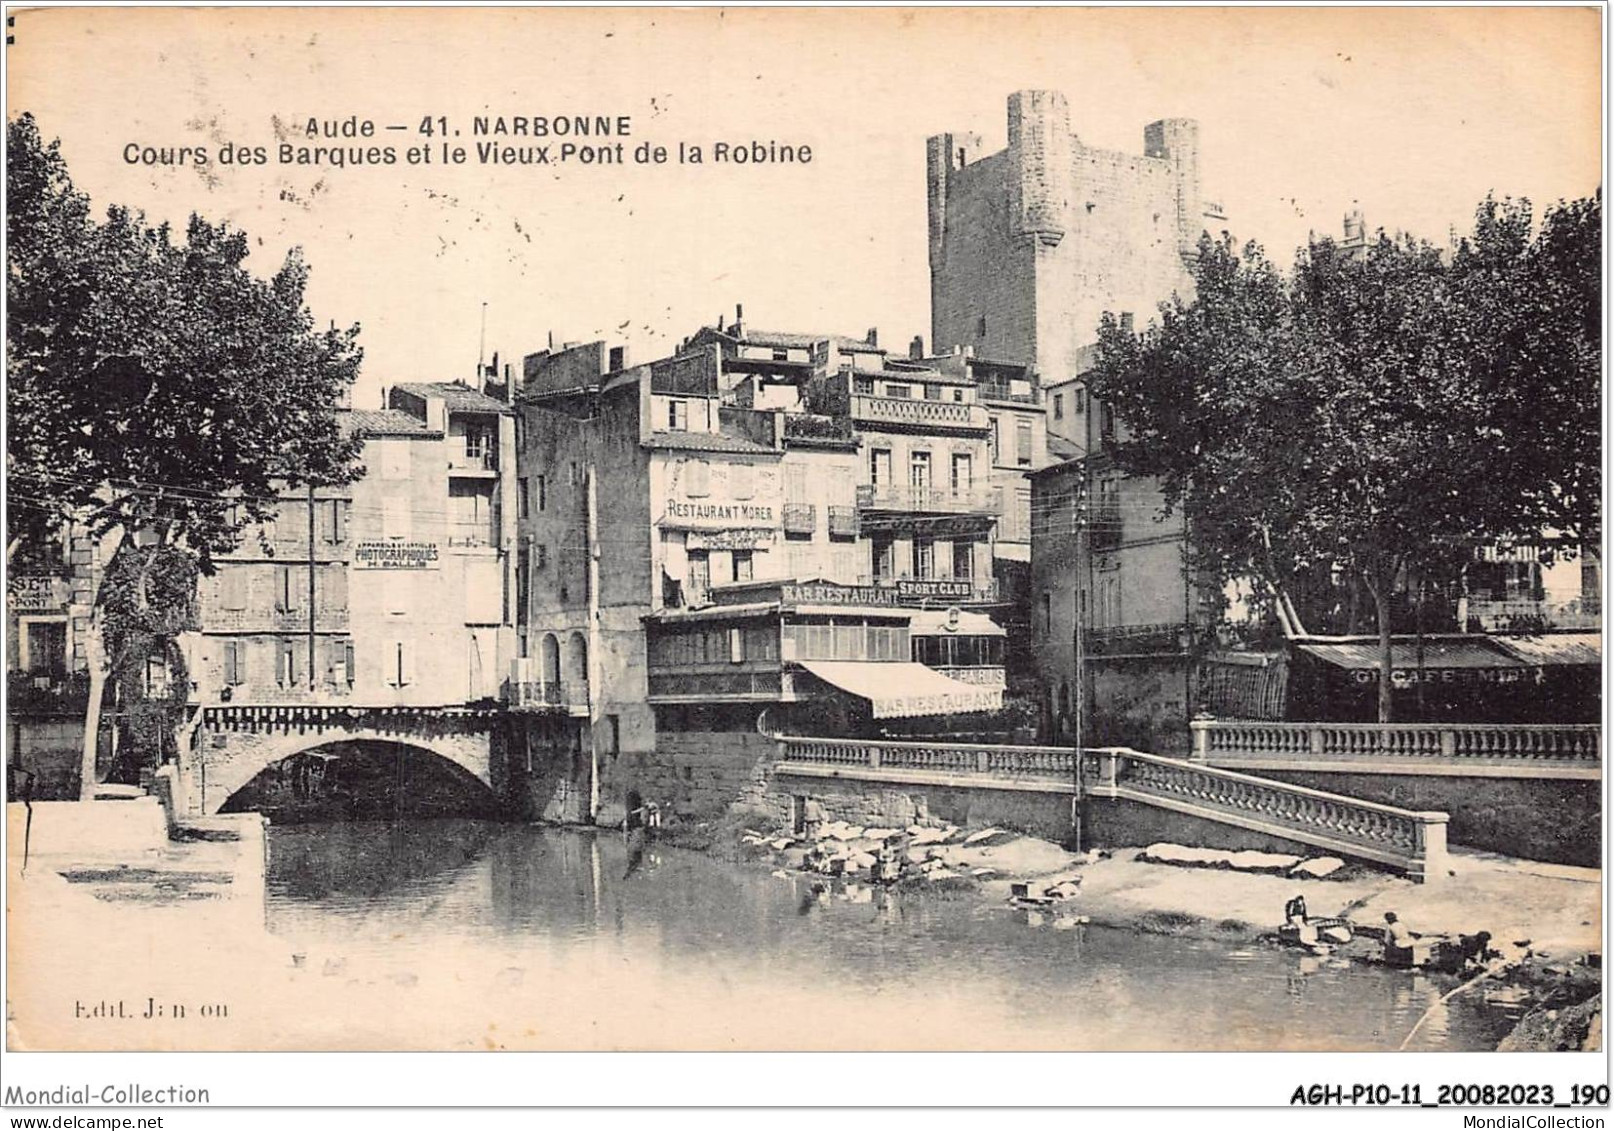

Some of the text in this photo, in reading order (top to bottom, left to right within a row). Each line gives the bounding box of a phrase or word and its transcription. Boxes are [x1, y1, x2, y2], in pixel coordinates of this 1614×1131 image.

[667, 498, 739, 520] RESTAURANT
[355, 549, 438, 561] PHOTOGRAPHIQUES
[899, 582, 970, 595] SPORT CLUB
[959, 669, 1005, 684] PARIS
[906, 691, 1000, 710] RESTAURANT
